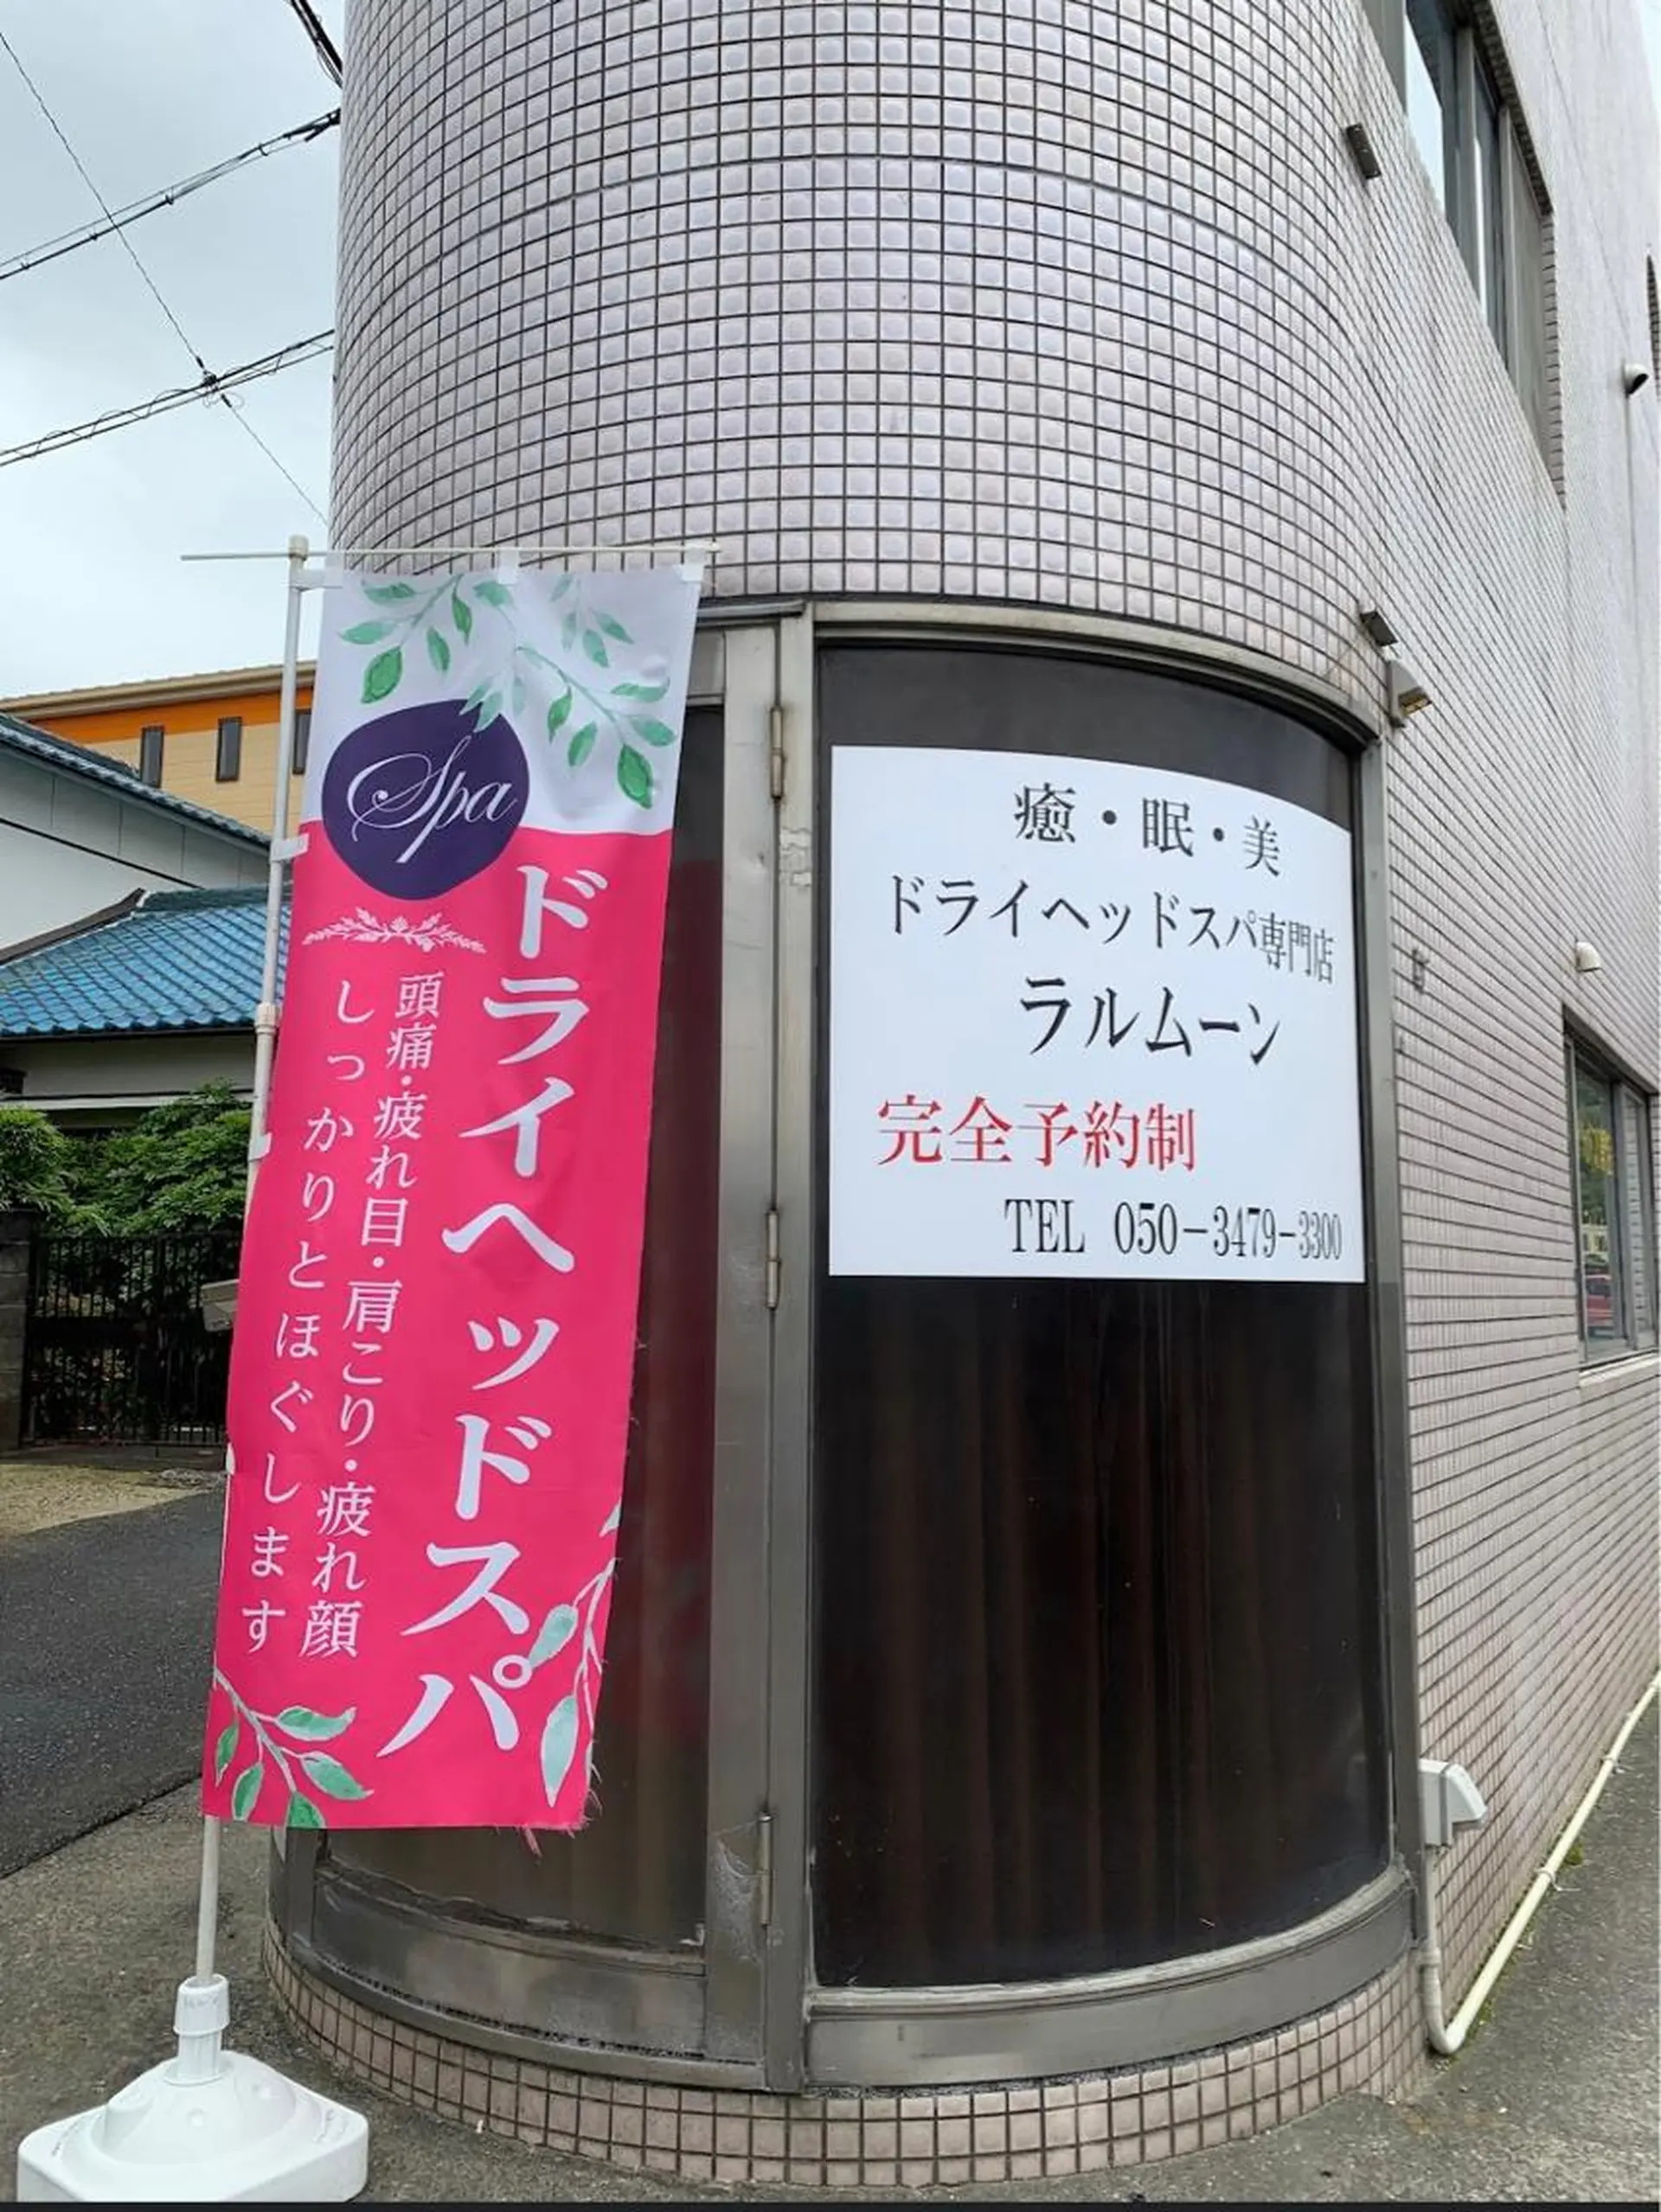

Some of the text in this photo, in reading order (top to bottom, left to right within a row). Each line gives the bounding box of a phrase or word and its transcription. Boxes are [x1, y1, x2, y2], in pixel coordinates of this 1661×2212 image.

[347, 734, 518, 864] Spa
[1013, 782, 1281, 877] 癒・眠・美
[891, 875, 1335, 984] ドライヘッドスパ専門店
[1019, 976, 1281, 1066] ラルムーン
[877, 1094, 1196, 1172] 完全予約制
[1004, 1199, 1086, 1254] TEL
[241, 979, 375, 1655] しっかりとほぐします
[299, 969, 446, 1659] 頭痛・疲れ目・肩こり・疲れ顔
[376, 864, 609, 1759] ドライヘッドスパ
